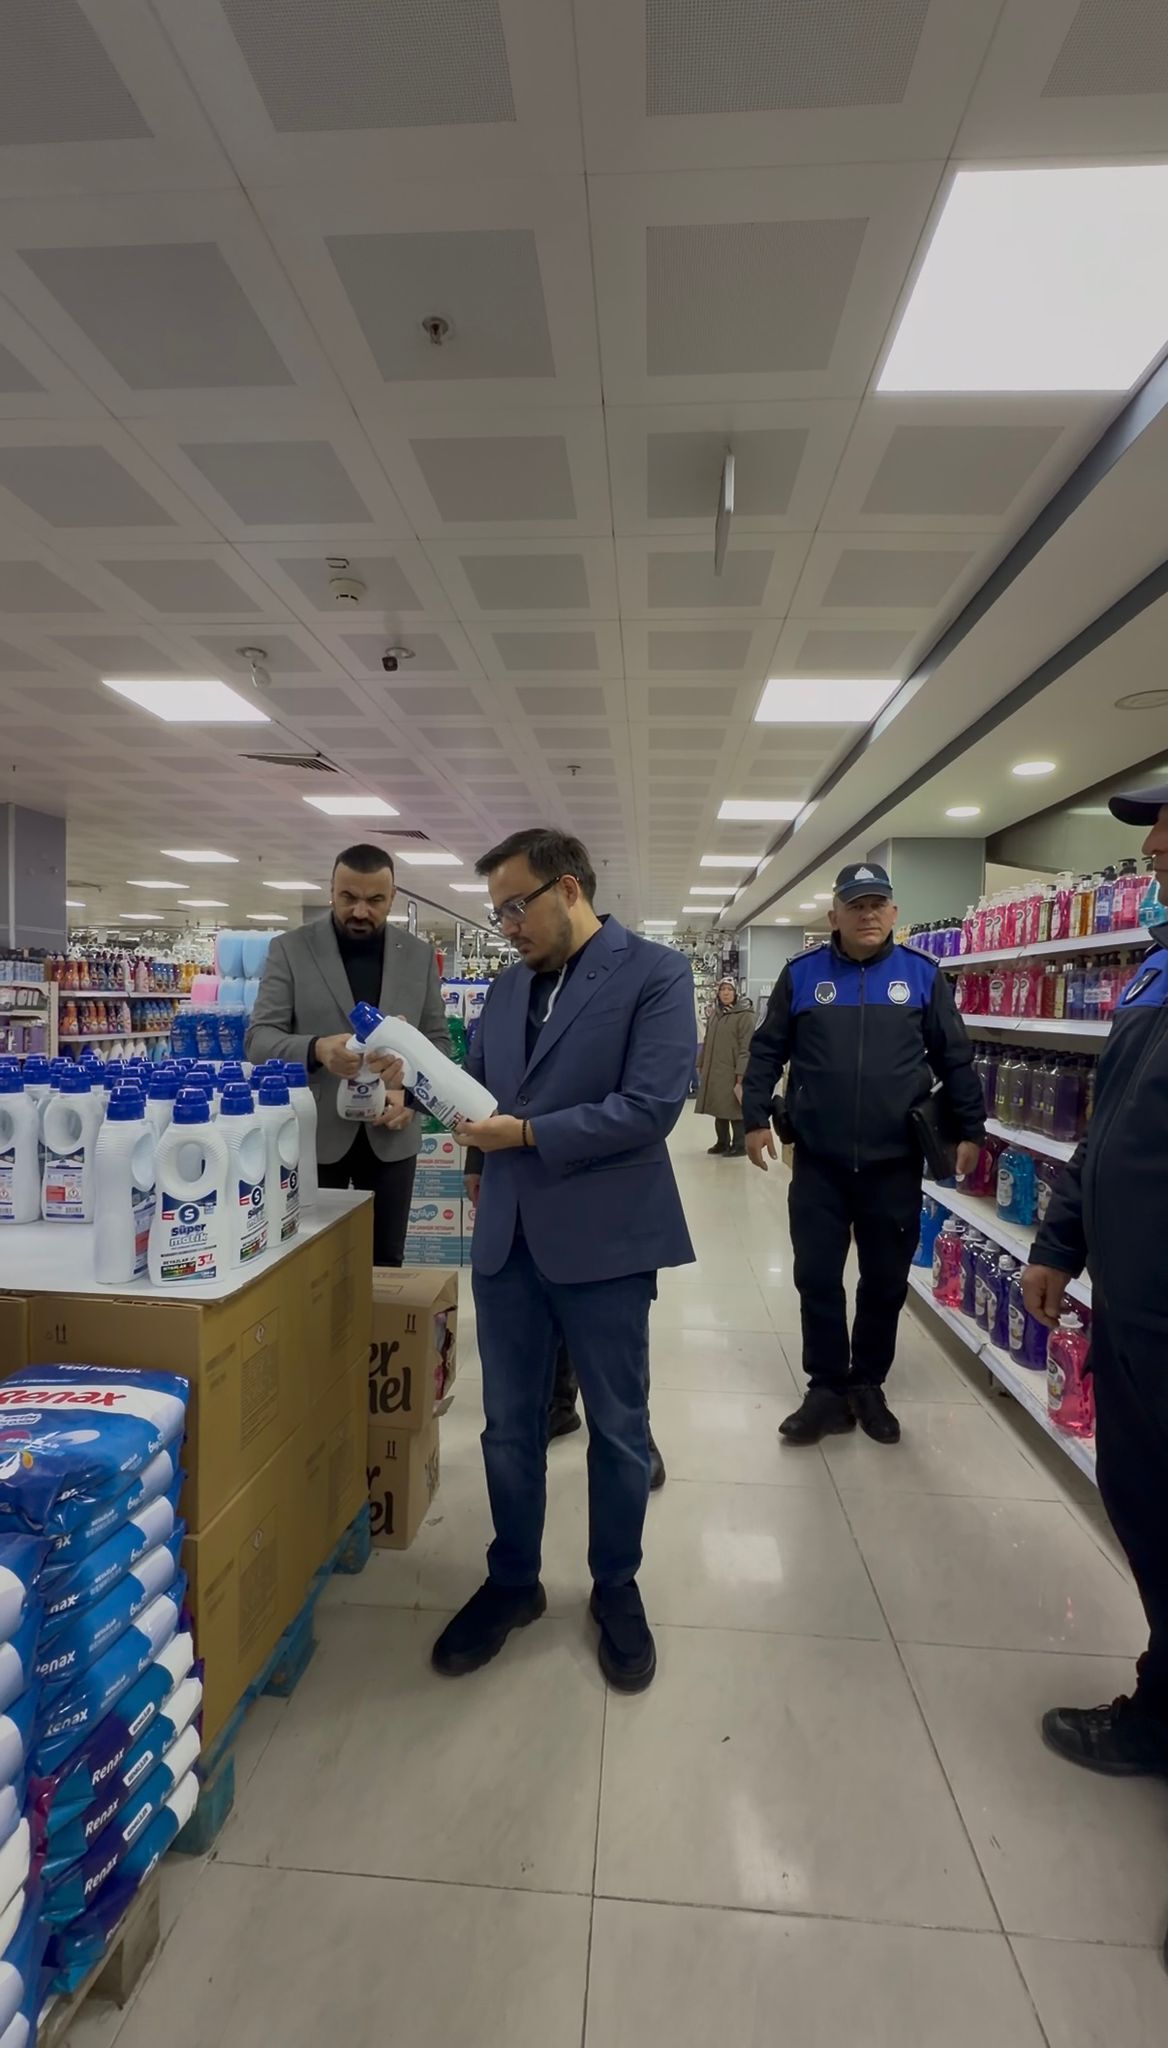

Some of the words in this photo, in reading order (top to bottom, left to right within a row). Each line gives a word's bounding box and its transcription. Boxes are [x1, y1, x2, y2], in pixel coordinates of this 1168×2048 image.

[184, 1208, 195, 1221] S
[169, 1232, 208, 1248] matik
[171, 1223, 207, 1237] Süper
[36, 1650, 76, 1676] enax
[92, 1747, 125, 1786] Renax
[85, 1798, 120, 1838] Renax
[84, 1853, 119, 1896] Renax
